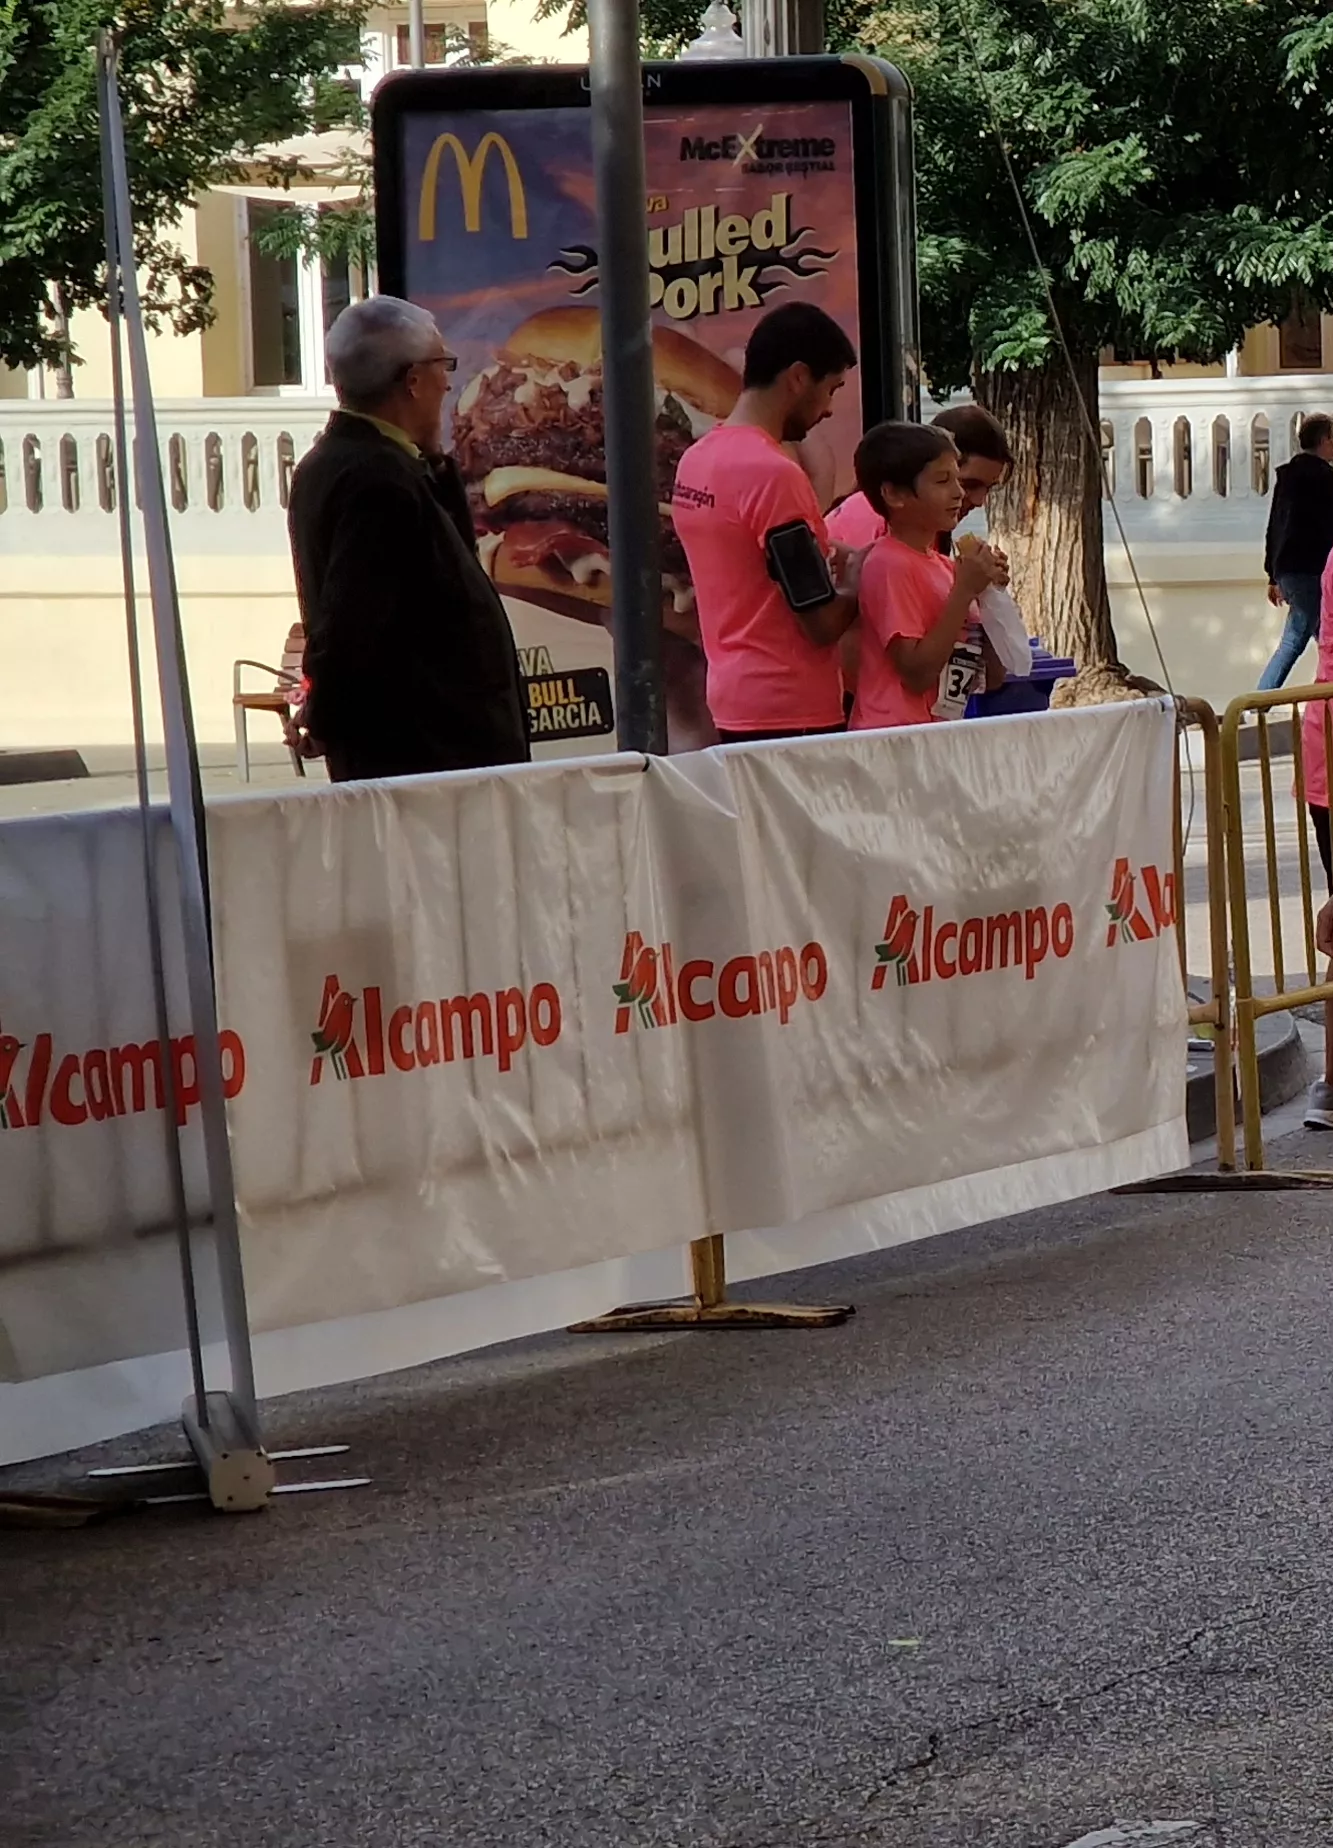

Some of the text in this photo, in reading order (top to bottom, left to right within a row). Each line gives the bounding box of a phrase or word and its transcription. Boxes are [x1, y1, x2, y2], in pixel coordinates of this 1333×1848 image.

[649, 192, 790, 268] ulled
[870, 894, 1074, 991] Alcampo
[310, 974, 562, 1087] Alcampo
